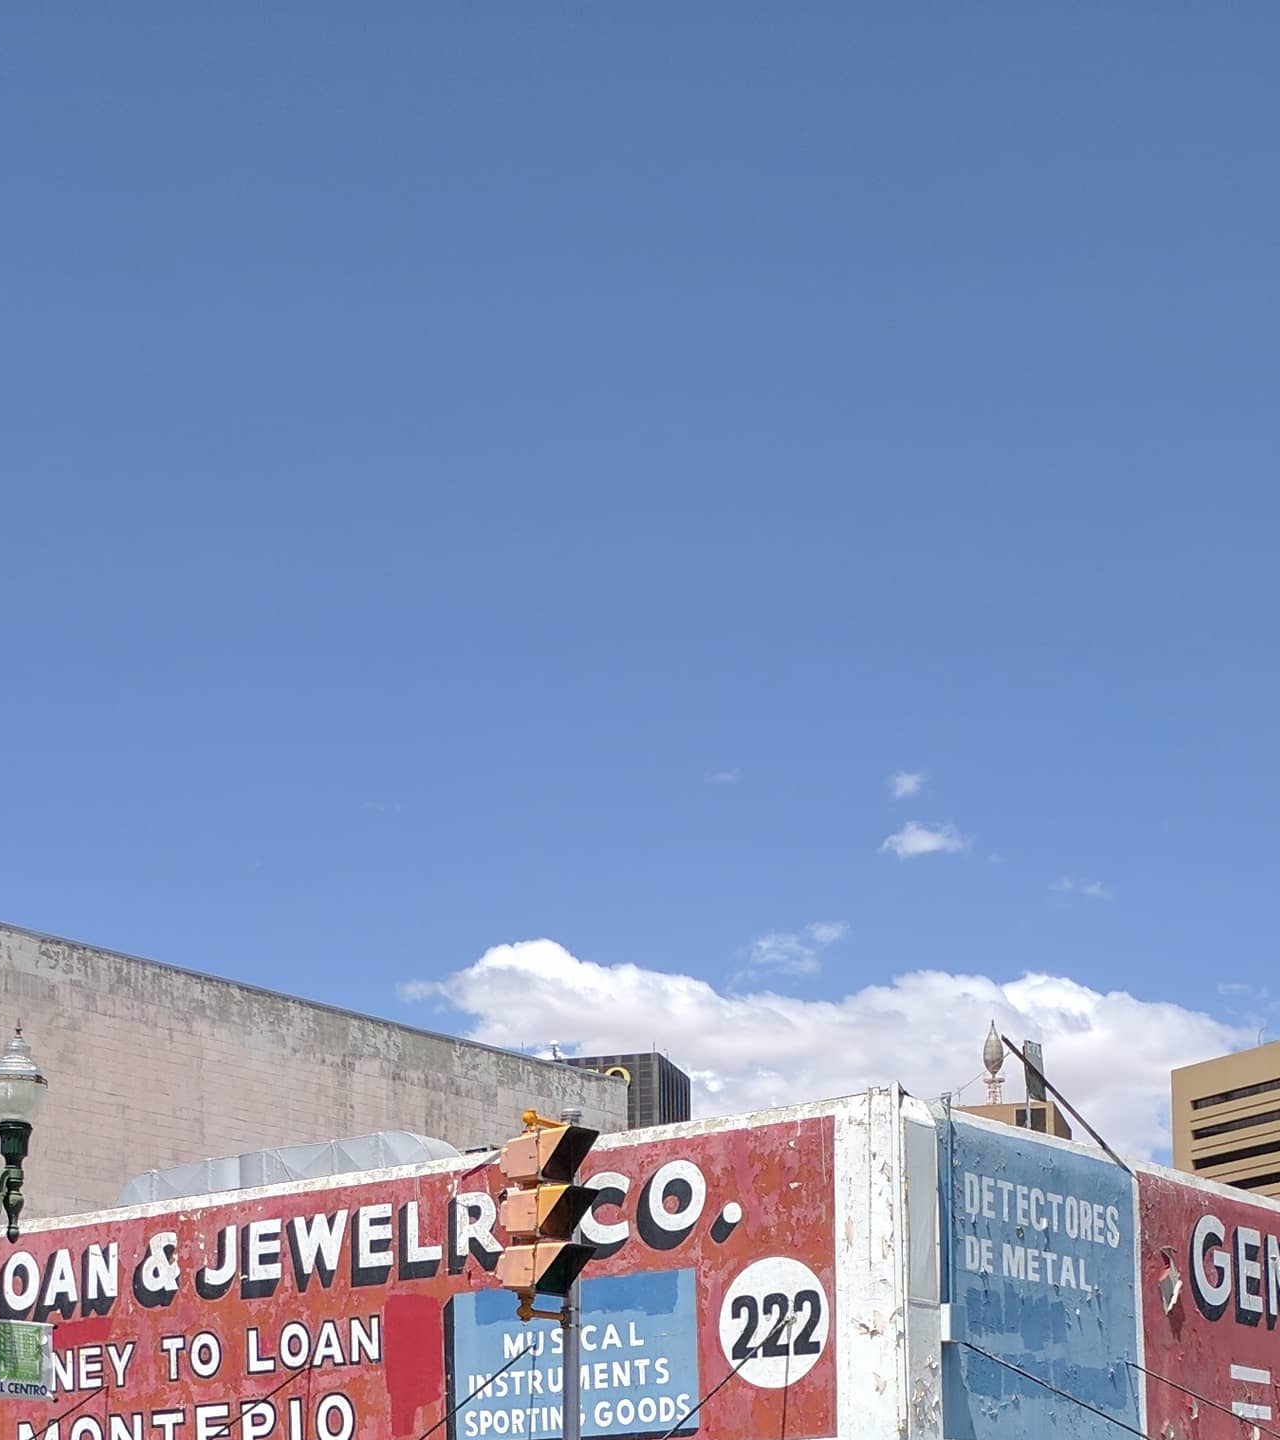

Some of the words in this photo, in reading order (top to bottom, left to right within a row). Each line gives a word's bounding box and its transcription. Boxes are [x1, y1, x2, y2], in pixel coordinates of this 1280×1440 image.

[141, 1231, 180, 1292] &
[201, 1190, 505, 1287] JEWELR
[578, 1159, 743, 1246] CO.
[965, 1173, 1120, 1250] DETECTORES
[965, 1235, 995, 1273] DE
[161, 1329, 221, 1382] TO
[246, 1316, 381, 1376] LOAN
[503, 1321, 645, 1359] MUSCAL
[729, 1290, 823, 1361] 222
[7, 1382, 48, 1396] CENTRO
[593, 1393, 692, 1429] GOODS
